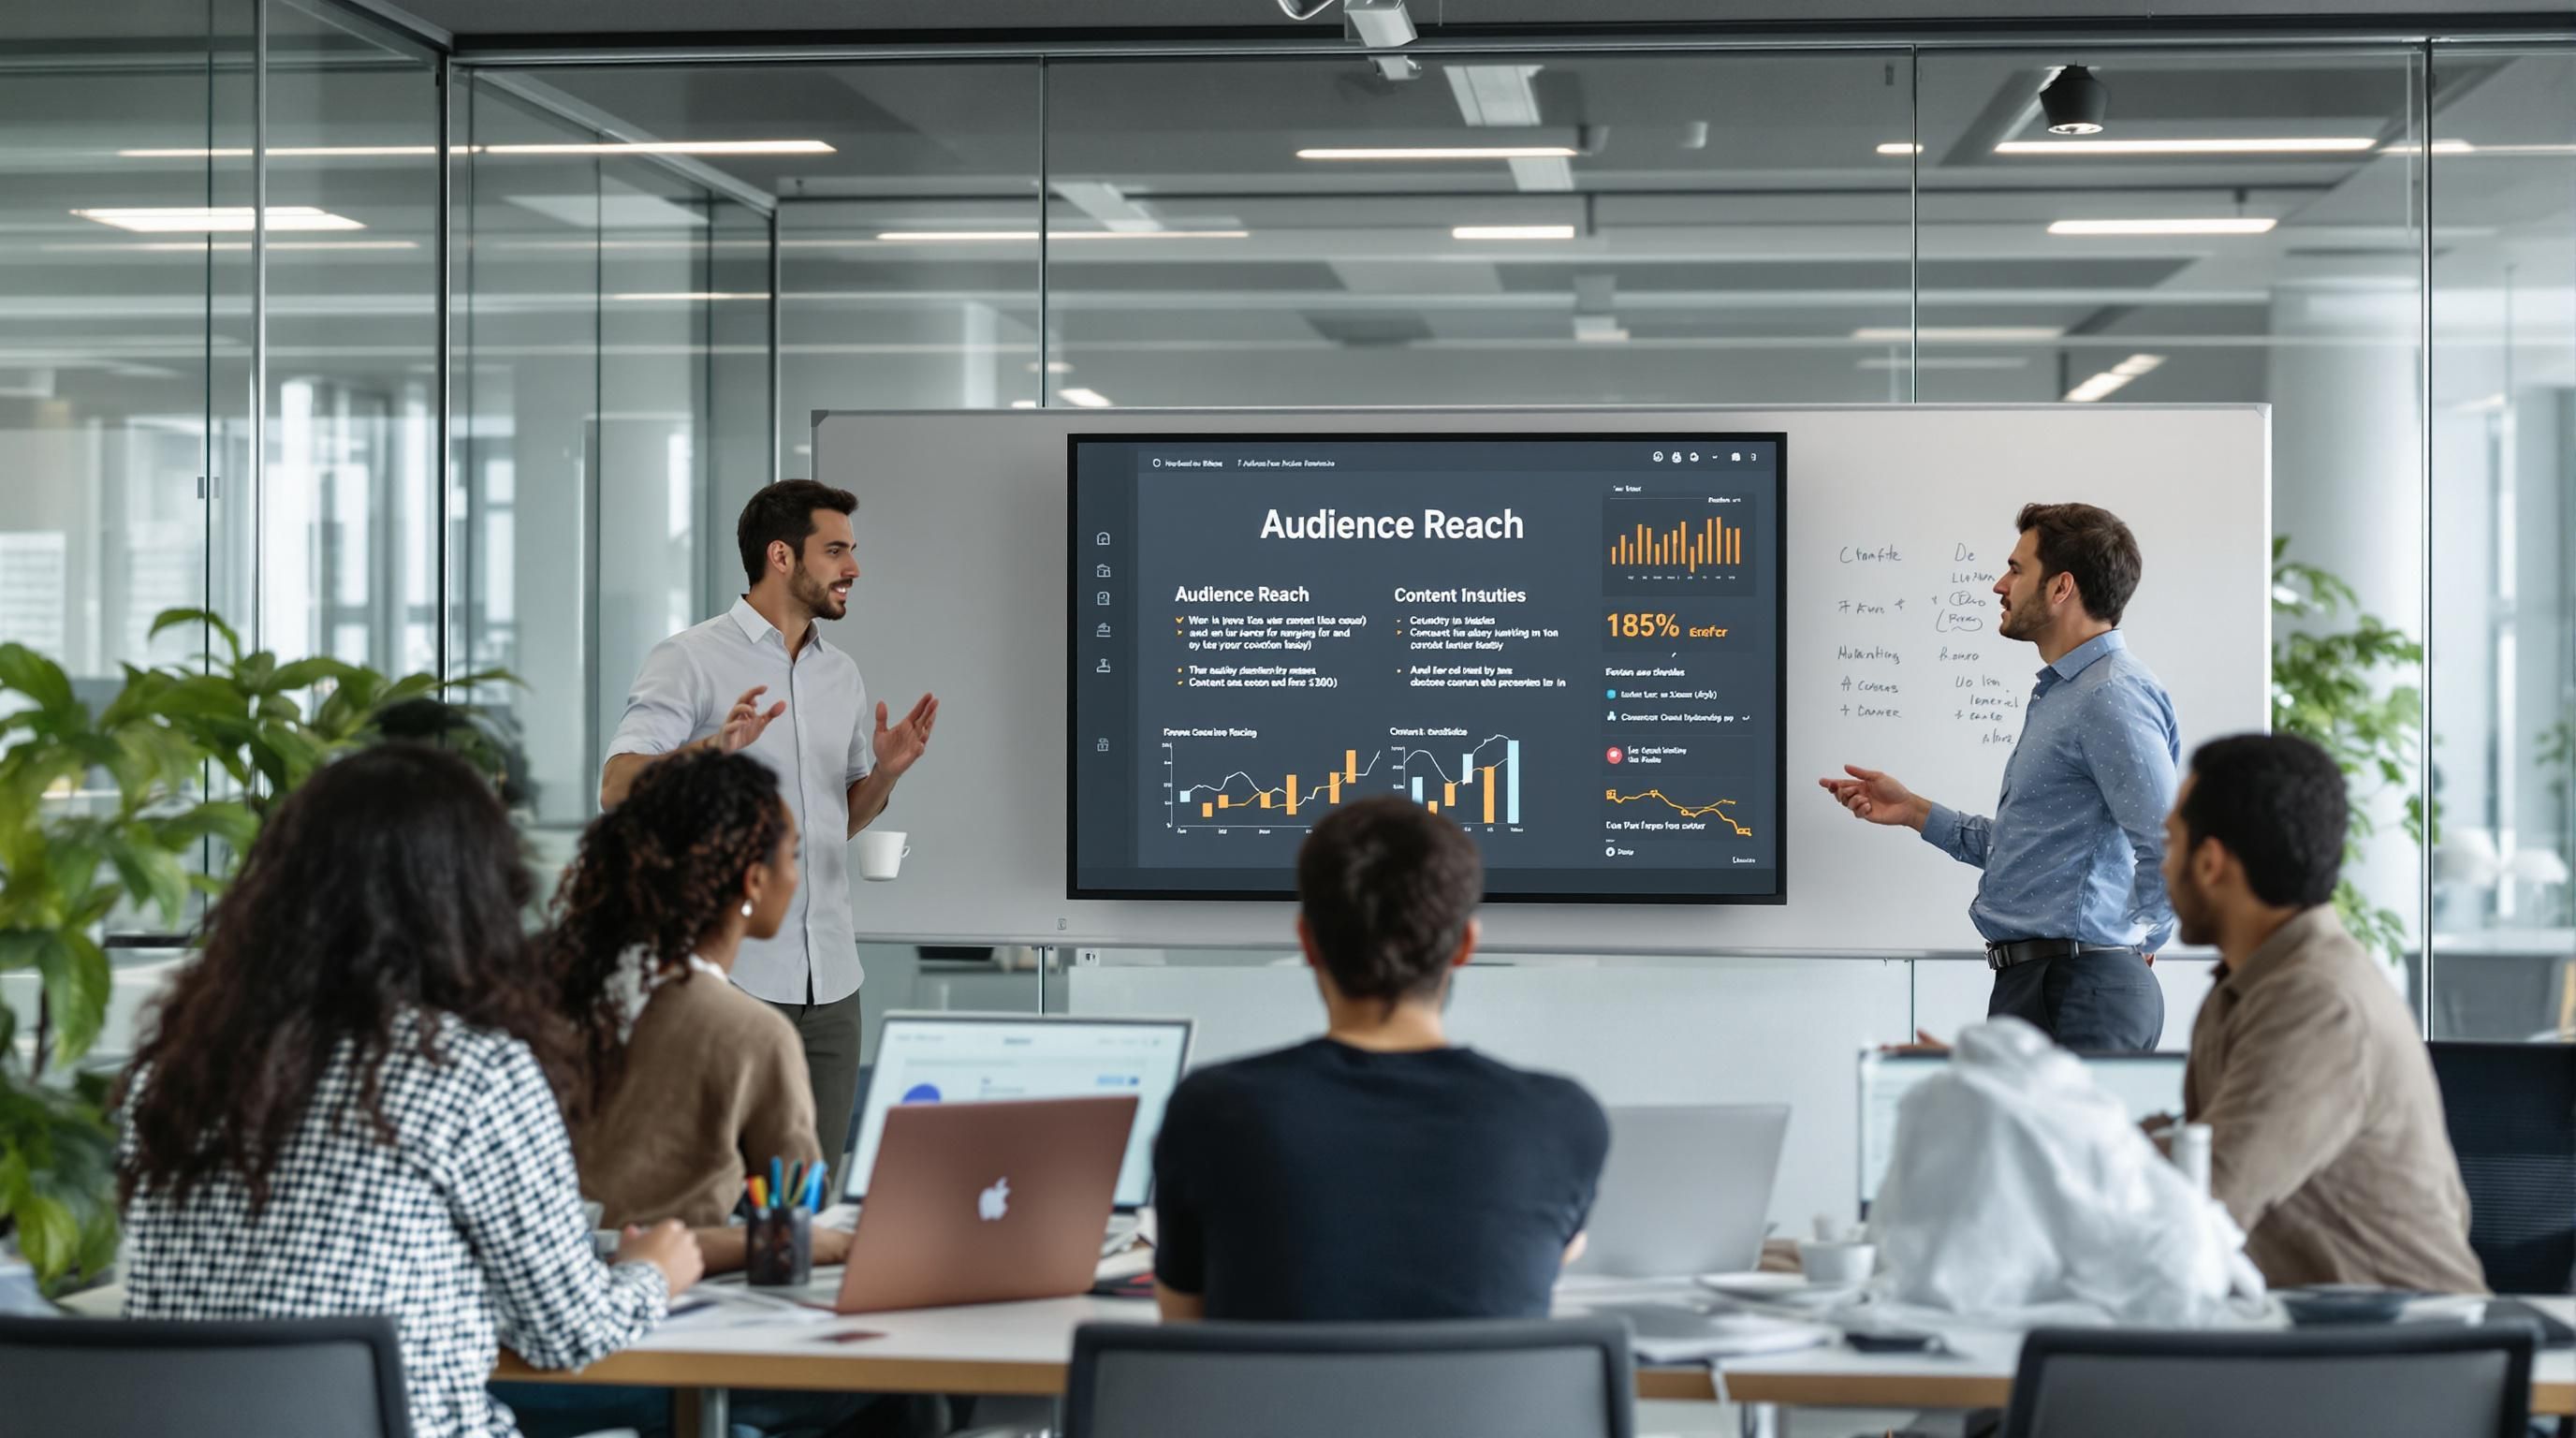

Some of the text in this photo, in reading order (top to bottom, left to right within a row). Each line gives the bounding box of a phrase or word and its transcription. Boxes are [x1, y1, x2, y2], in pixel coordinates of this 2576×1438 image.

[1260, 508, 1524, 539] Audience Reach
[1175, 586, 1310, 602] Audience Reach
[1394, 588, 1457, 603] Content
[1607, 613, 1680, 638] 185%
